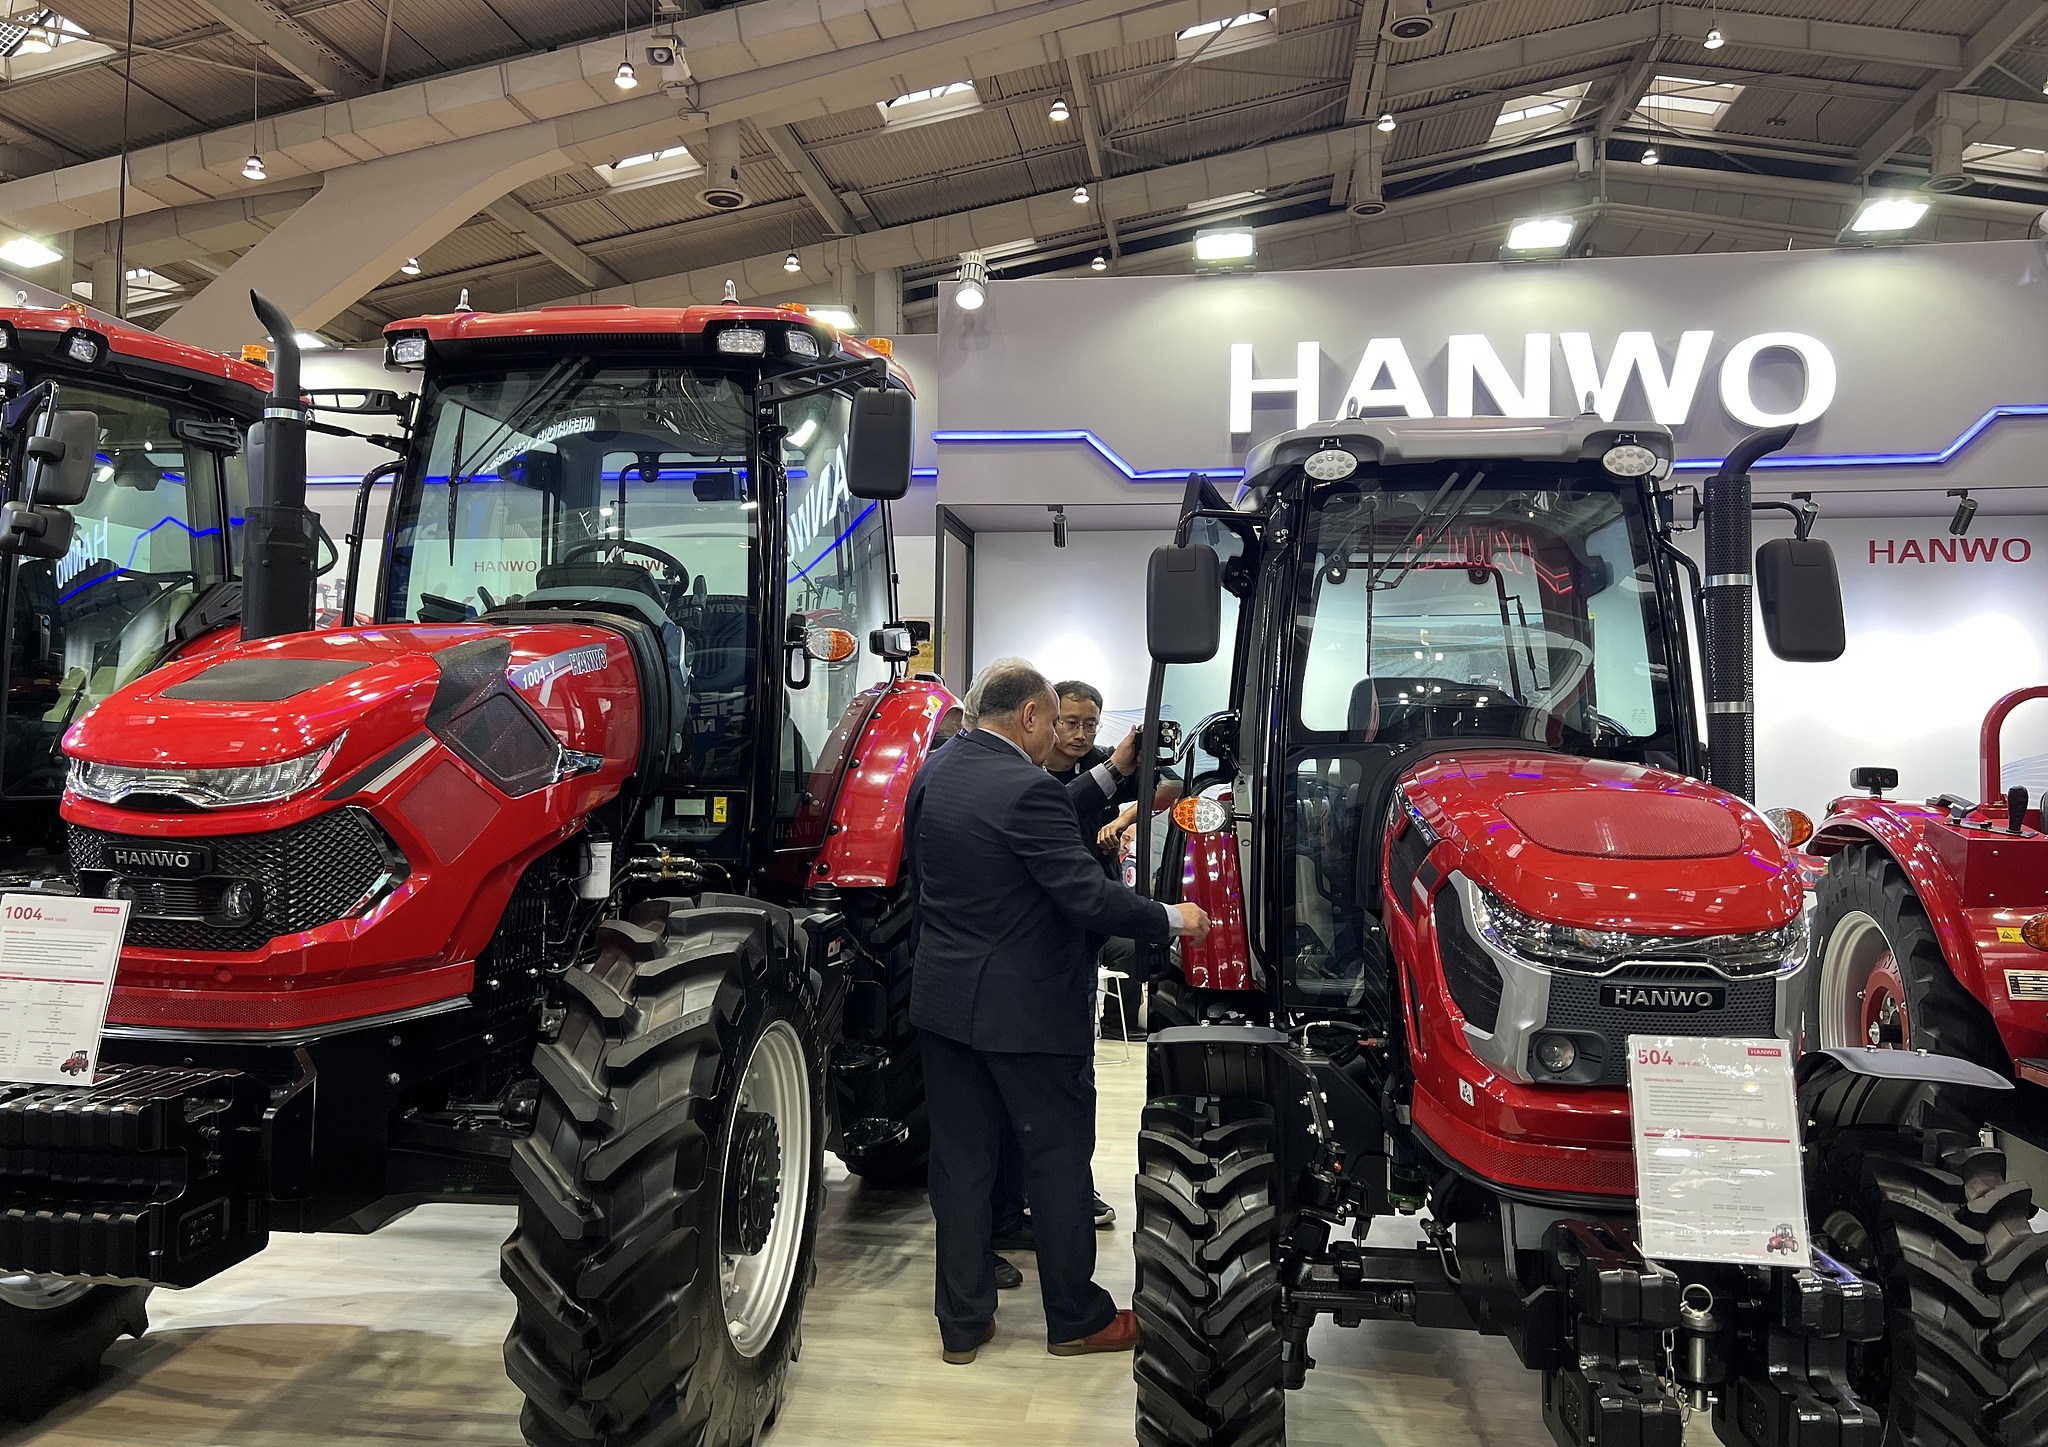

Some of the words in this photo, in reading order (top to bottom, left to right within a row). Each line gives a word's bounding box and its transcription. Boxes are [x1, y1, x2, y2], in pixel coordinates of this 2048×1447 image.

[1231, 330, 1837, 434] HANWO
[1868, 538, 2032, 564] HANWO
[474, 560, 537, 573] HANWO
[522, 660, 555, 690] 1004-Y
[568, 647, 608, 676] HANWO
[115, 850, 190, 868] HANWO
[5, 906, 42, 921] 1004
[1614, 989, 1713, 1007] HANWO
[1638, 1049, 1674, 1066] 504
